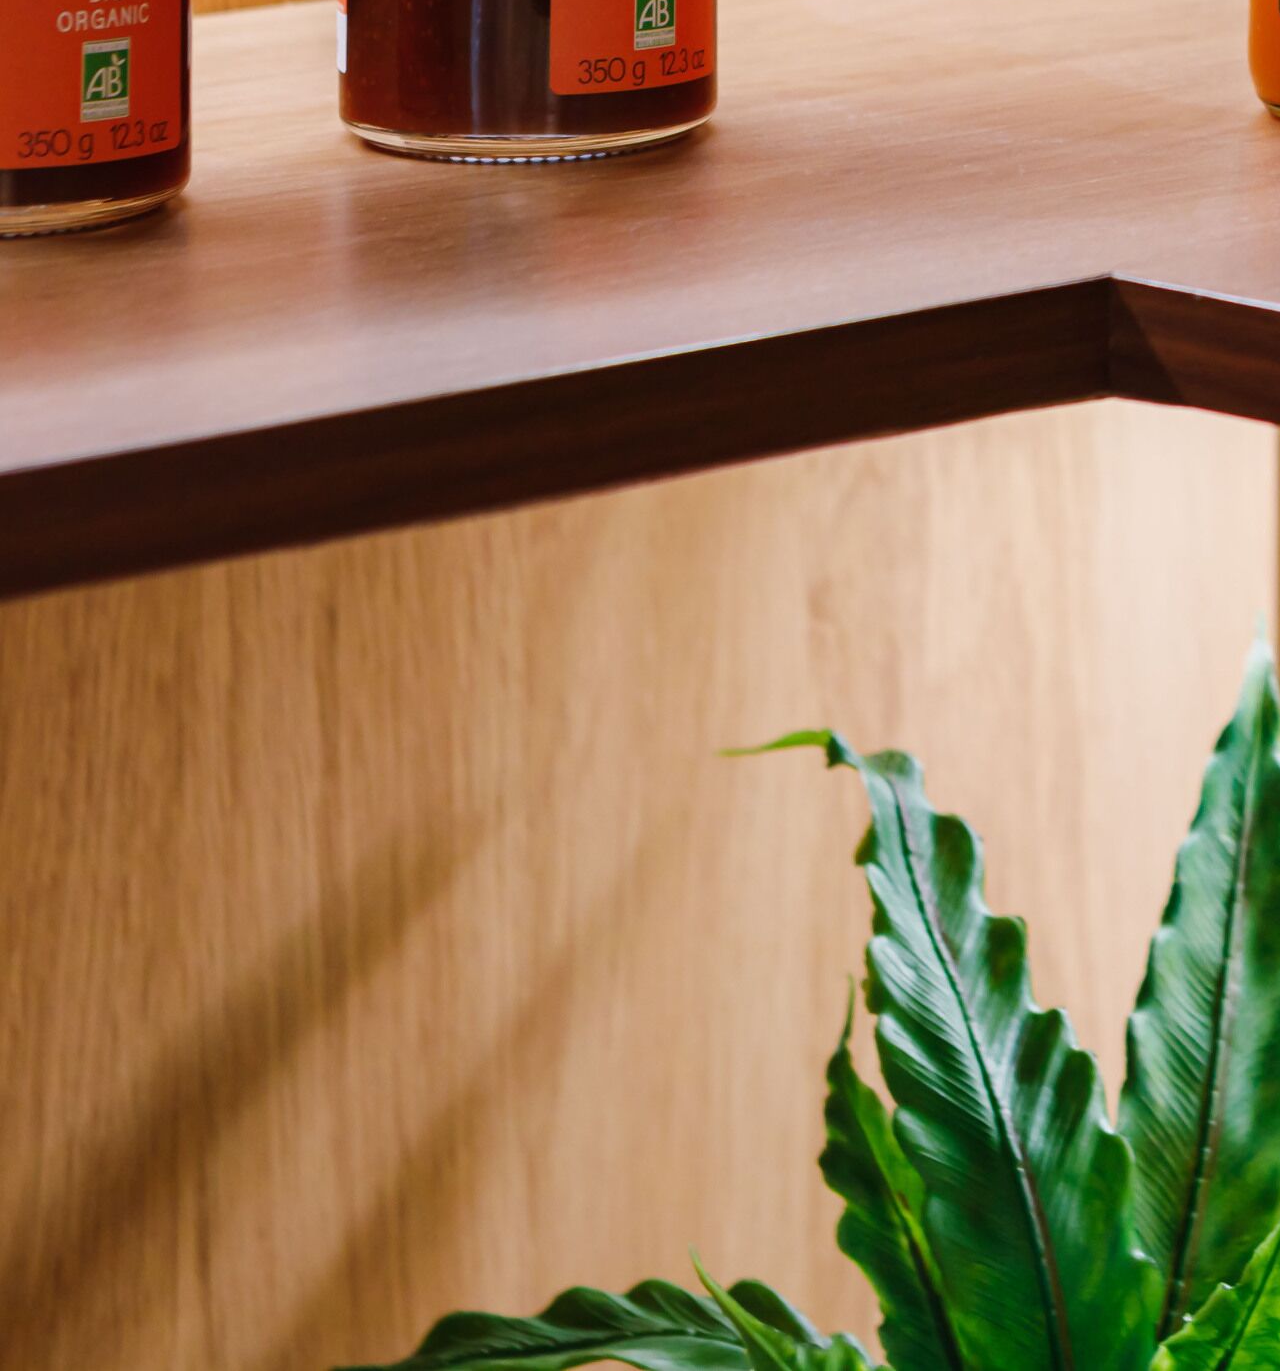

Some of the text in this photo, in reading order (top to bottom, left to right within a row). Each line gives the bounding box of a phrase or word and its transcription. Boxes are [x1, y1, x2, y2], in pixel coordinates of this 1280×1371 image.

[56, 2, 150, 33] ORGANIC
[86, 66, 122, 100] AB
[578, 57, 626, 84] 350
[632, 61, 645, 86] g
[692, 49, 704, 69] oz
[17, 128, 72, 158] 350
[78, 132, 95, 160] g
[150, 120, 169, 143] oz
